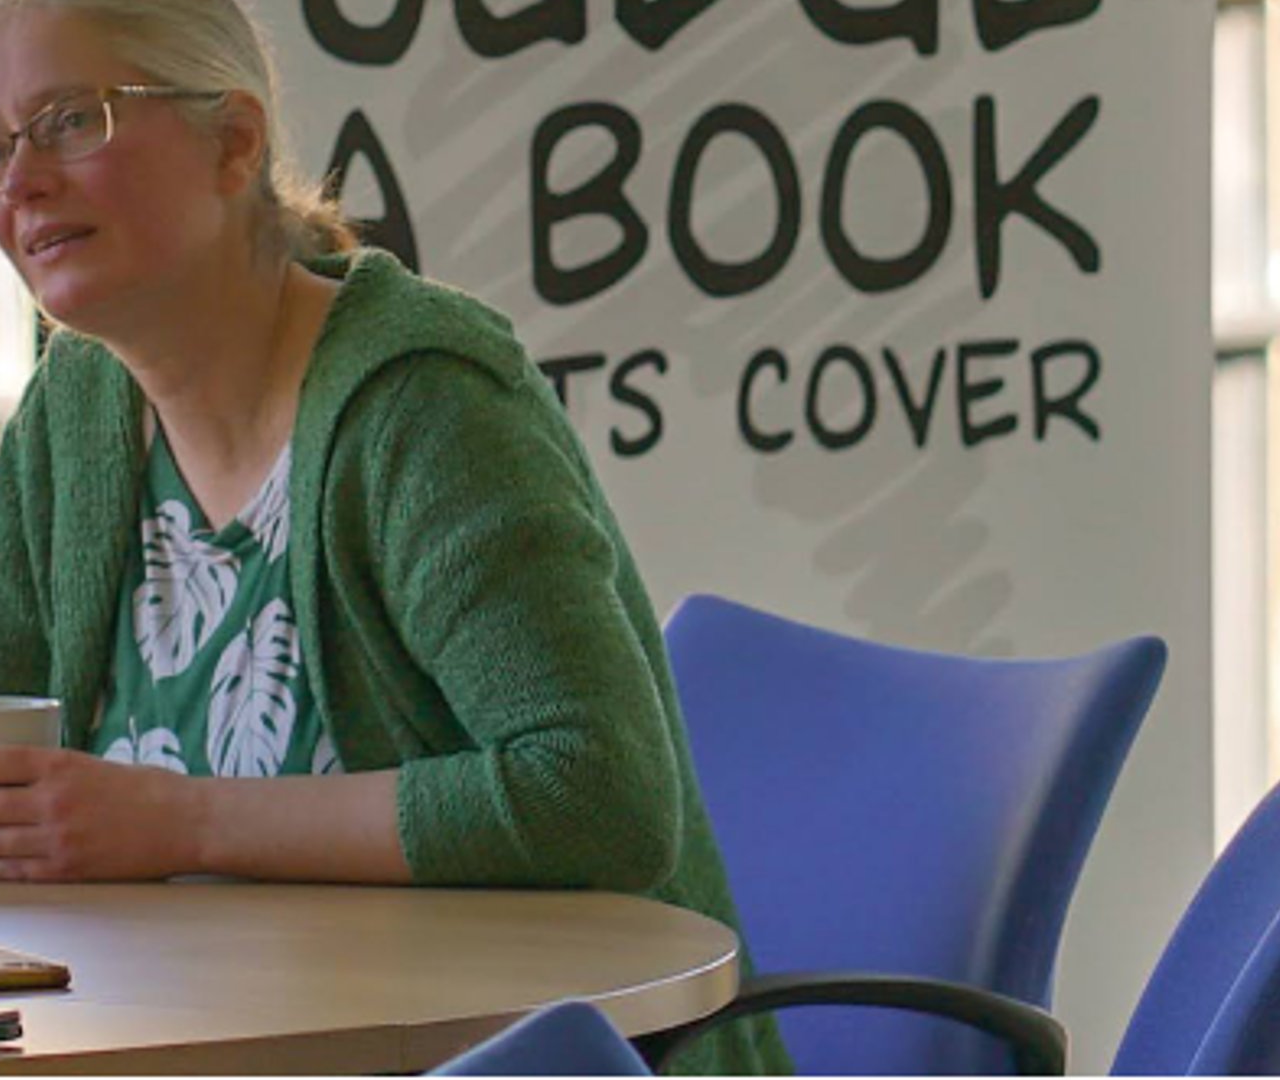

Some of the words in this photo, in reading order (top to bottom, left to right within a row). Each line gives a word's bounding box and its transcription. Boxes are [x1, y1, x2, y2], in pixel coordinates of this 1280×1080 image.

[321, 108, 420, 274] A
[530, 95, 1101, 306] BOOK
[737, 339, 1101, 454] COVER
